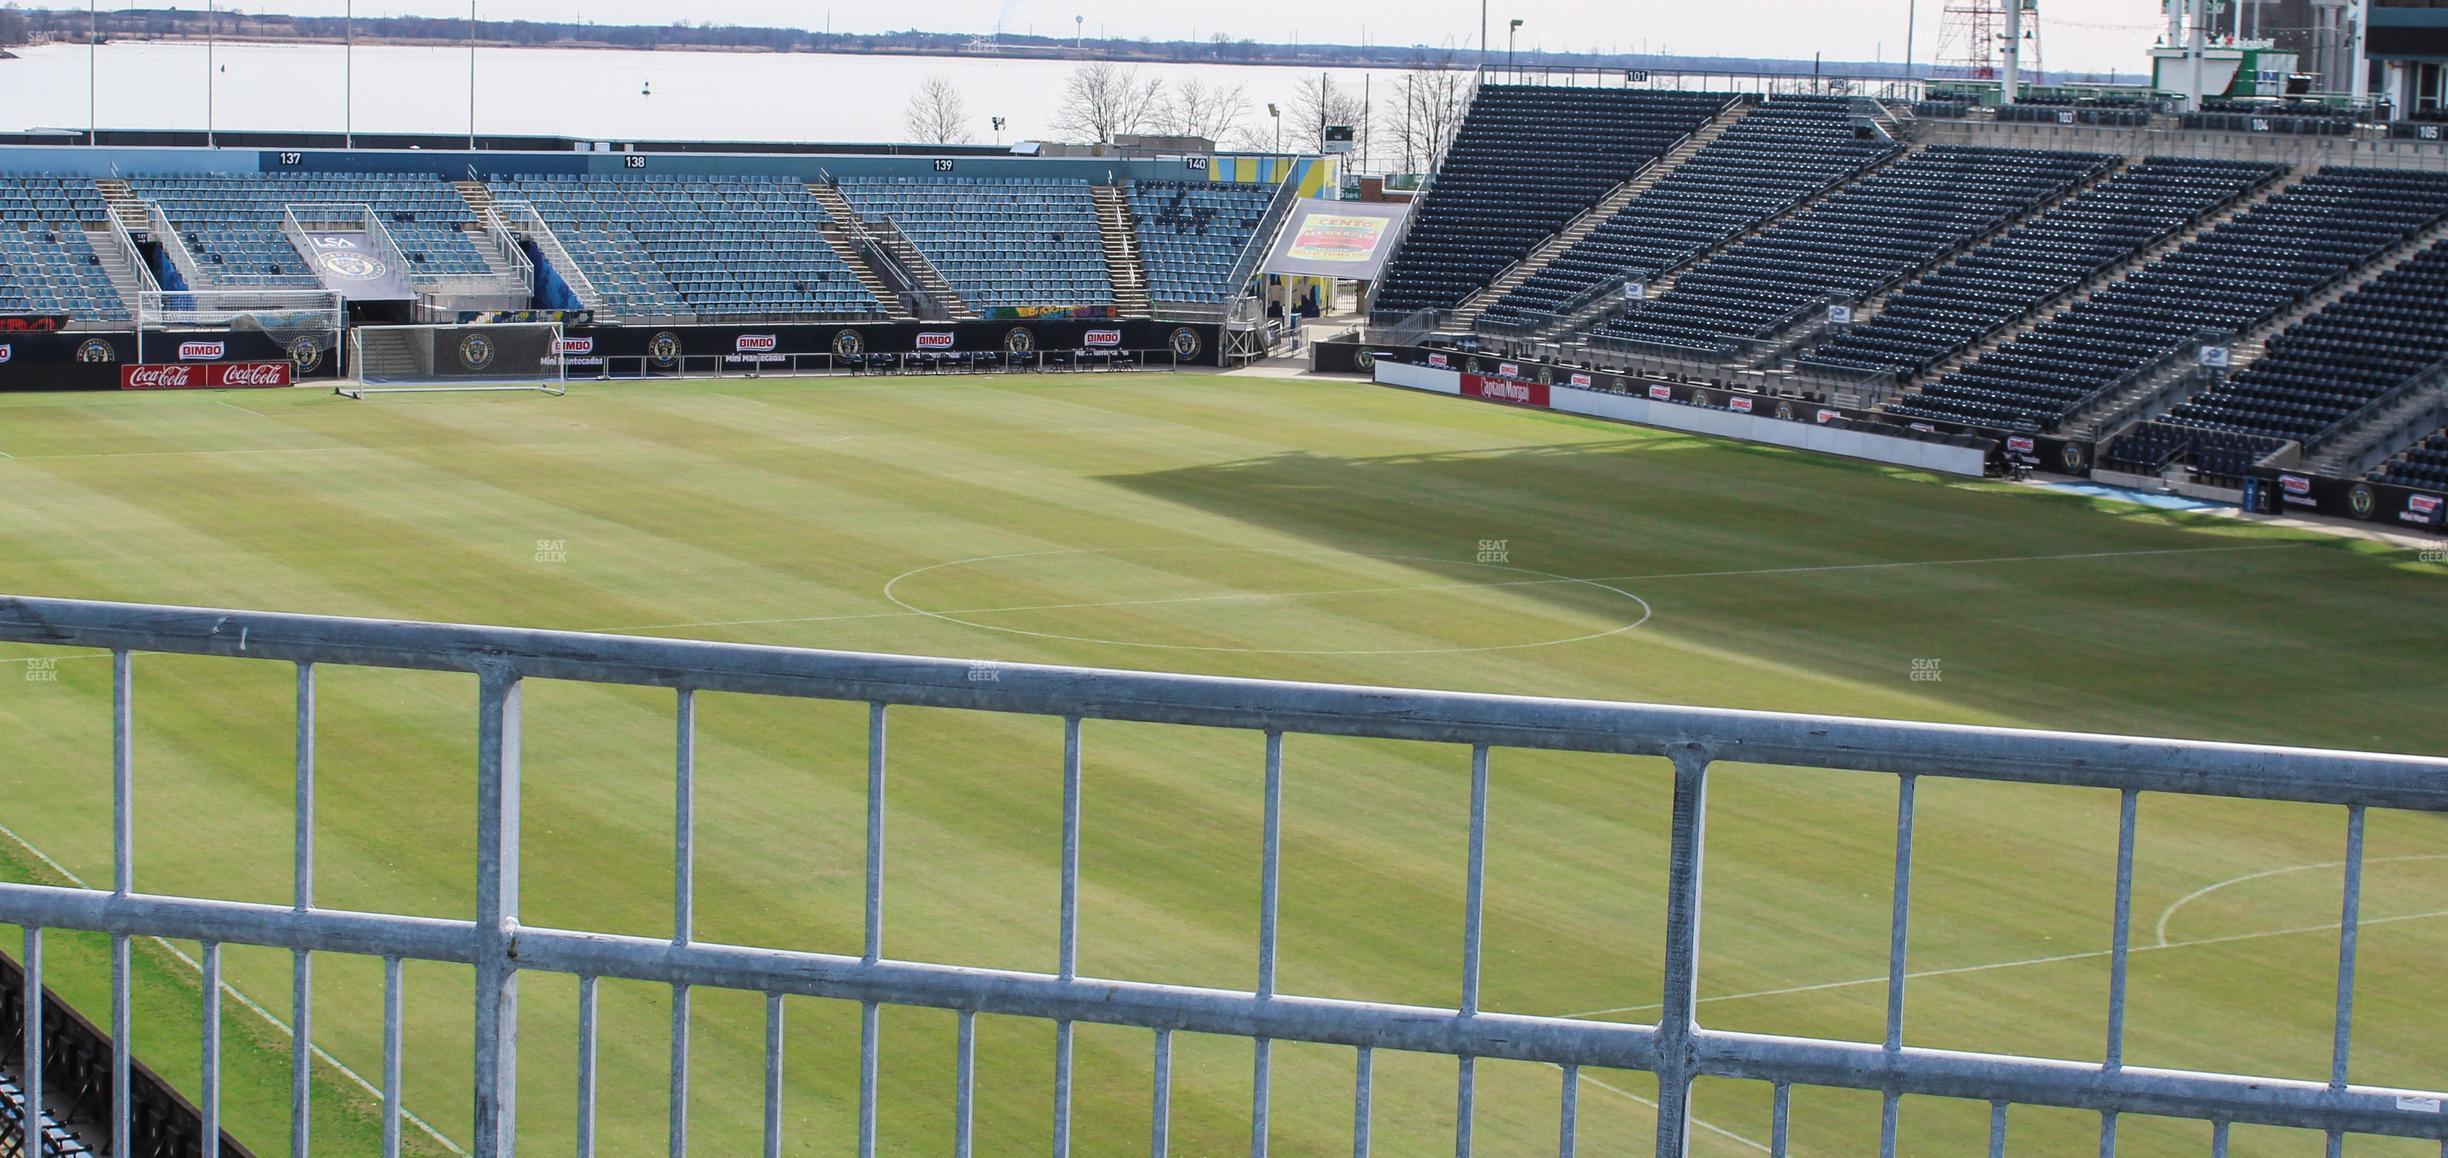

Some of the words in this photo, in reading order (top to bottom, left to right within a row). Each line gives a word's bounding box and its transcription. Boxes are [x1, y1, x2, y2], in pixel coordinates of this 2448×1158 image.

[1629, 72, 1646, 80] 101
[2420, 126, 2438, 139] 105
[280, 152, 301, 164] 137
[626, 156, 645, 168] 138
[935, 160, 952, 171] 139
[1188, 159, 1206, 169] 140
[740, 339, 773, 347] BIMBO
[919, 336, 951, 345] BIMBO
[1087, 334, 1118, 342] BIMBO
[183, 345, 221, 355] BIMBO
[130, 366, 191, 387] Coca-Cola
[223, 365, 284, 386] Coca-Cola
[1481, 377, 1505, 398] Captain
